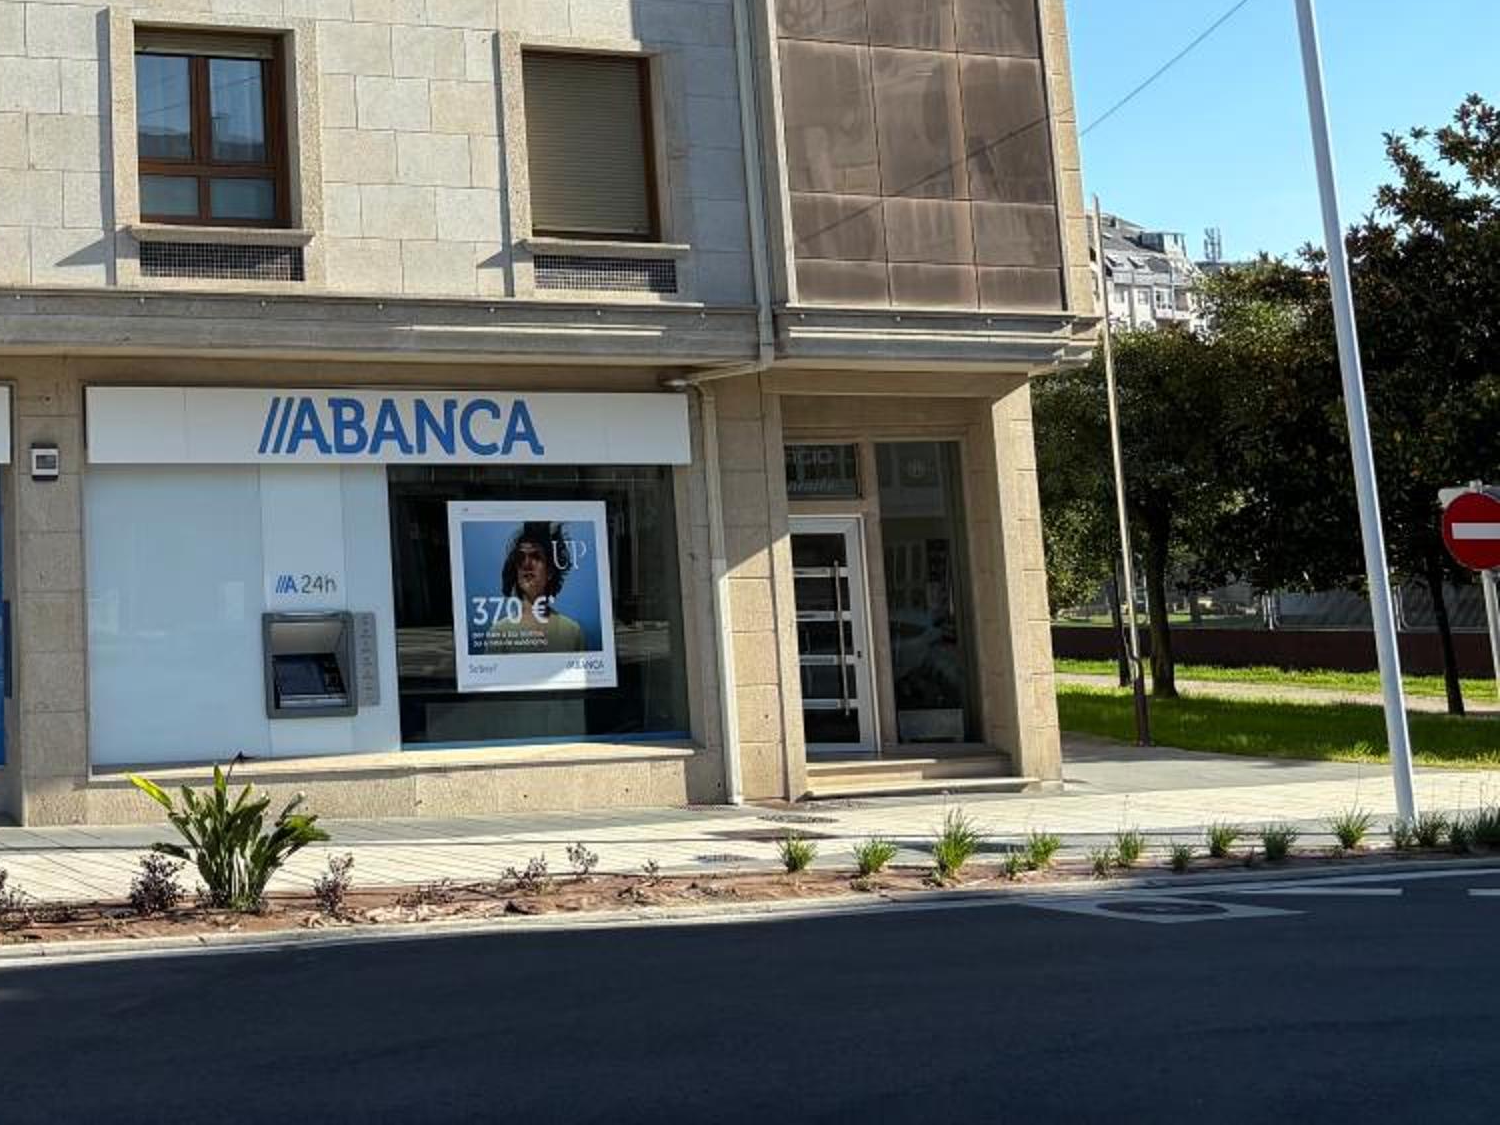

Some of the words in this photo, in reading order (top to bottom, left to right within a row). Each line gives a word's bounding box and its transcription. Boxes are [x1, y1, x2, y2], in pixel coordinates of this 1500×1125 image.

[551, 539, 587, 569] UP
[301, 574, 337, 594] 24h
[472, 597, 523, 625] 370
